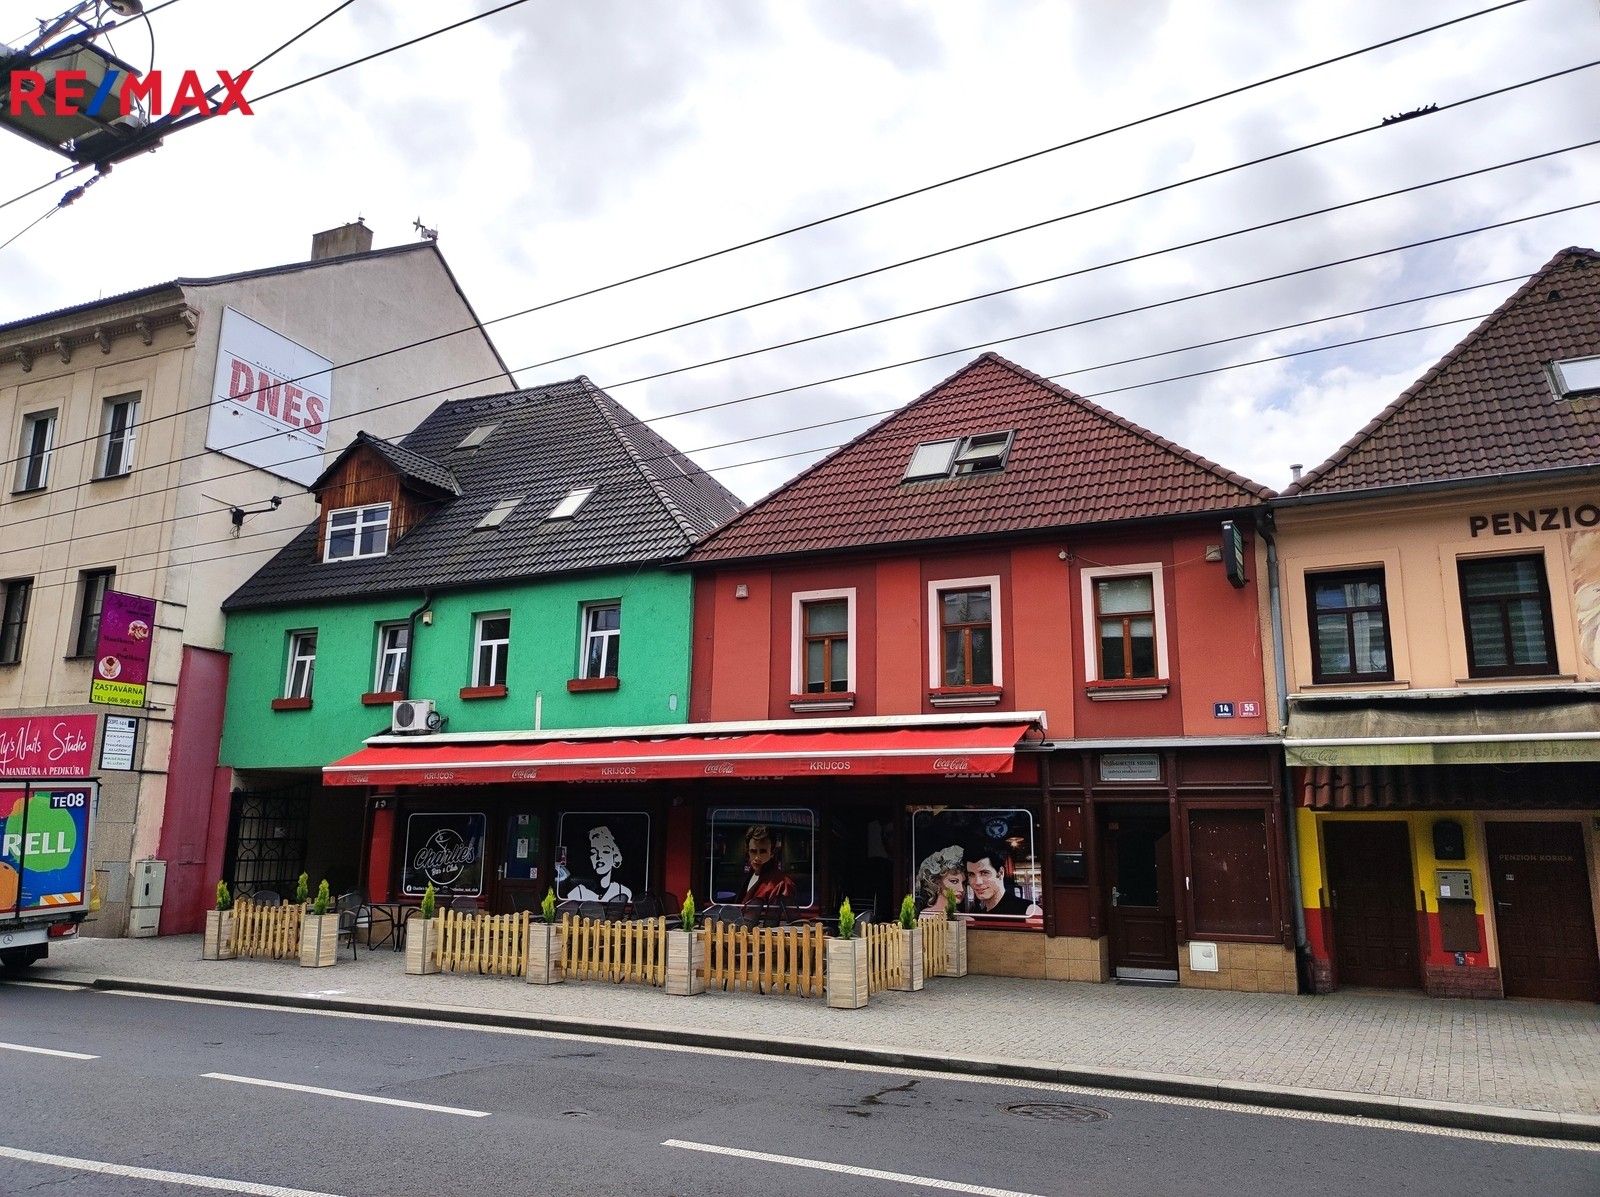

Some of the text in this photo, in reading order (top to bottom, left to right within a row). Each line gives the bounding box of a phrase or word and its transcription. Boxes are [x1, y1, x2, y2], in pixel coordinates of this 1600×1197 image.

[229, 358, 324, 435] DNES
[1469, 503, 1600, 538] PENZIO
[94, 682, 144, 695] ZASTAVÁRNA
[1219, 704, 1230, 713] 14
[1244, 703, 1255, 712] 55
[16, 720, 42, 760] Nails
[48, 722, 87, 760] Studio
[6, 765, 42, 776] MANIKÚRA
[42, 767, 48, 776] A
[49, 765, 84, 776] PEDIKÚRA
[809, 761, 851, 771] KRIJCOS
[2, 831, 71, 857] RELL
